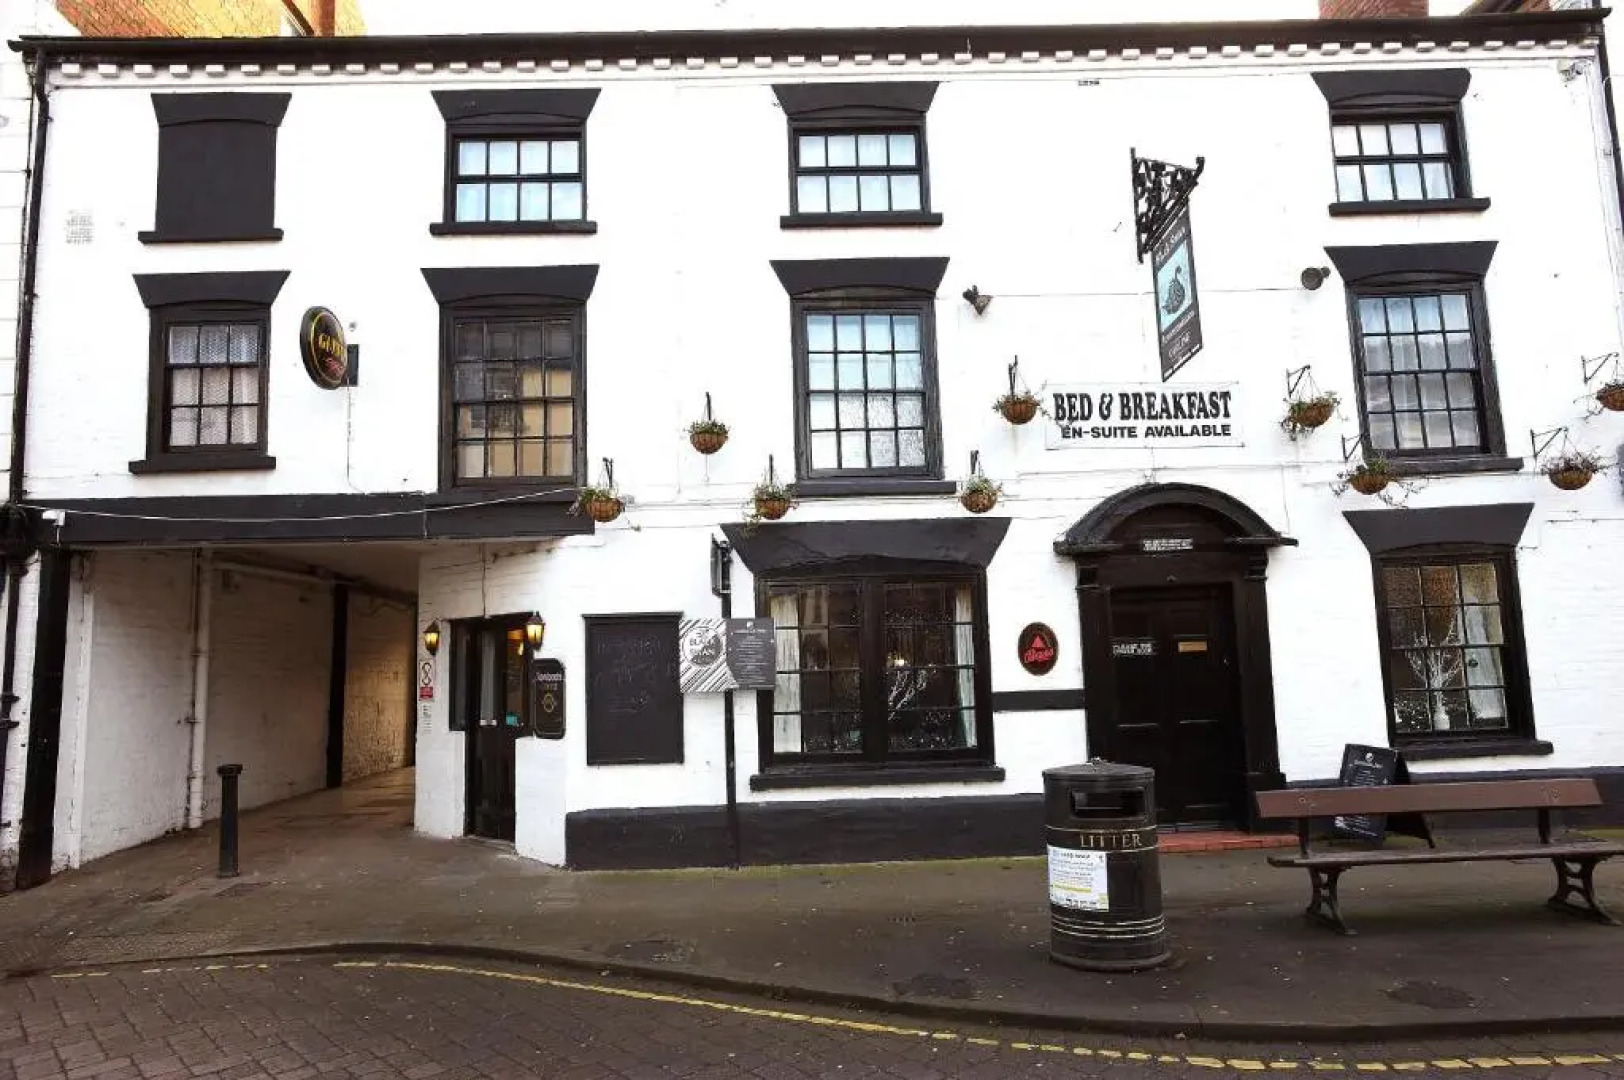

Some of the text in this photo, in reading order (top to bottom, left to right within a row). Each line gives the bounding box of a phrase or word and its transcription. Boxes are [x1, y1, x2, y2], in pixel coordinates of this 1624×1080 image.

[1053, 391, 1232, 421] BED & BREAKFAST
[1061, 424, 1232, 439] EN-SUITE AVAILABLE
[1079, 833, 1143, 848] LITTER
